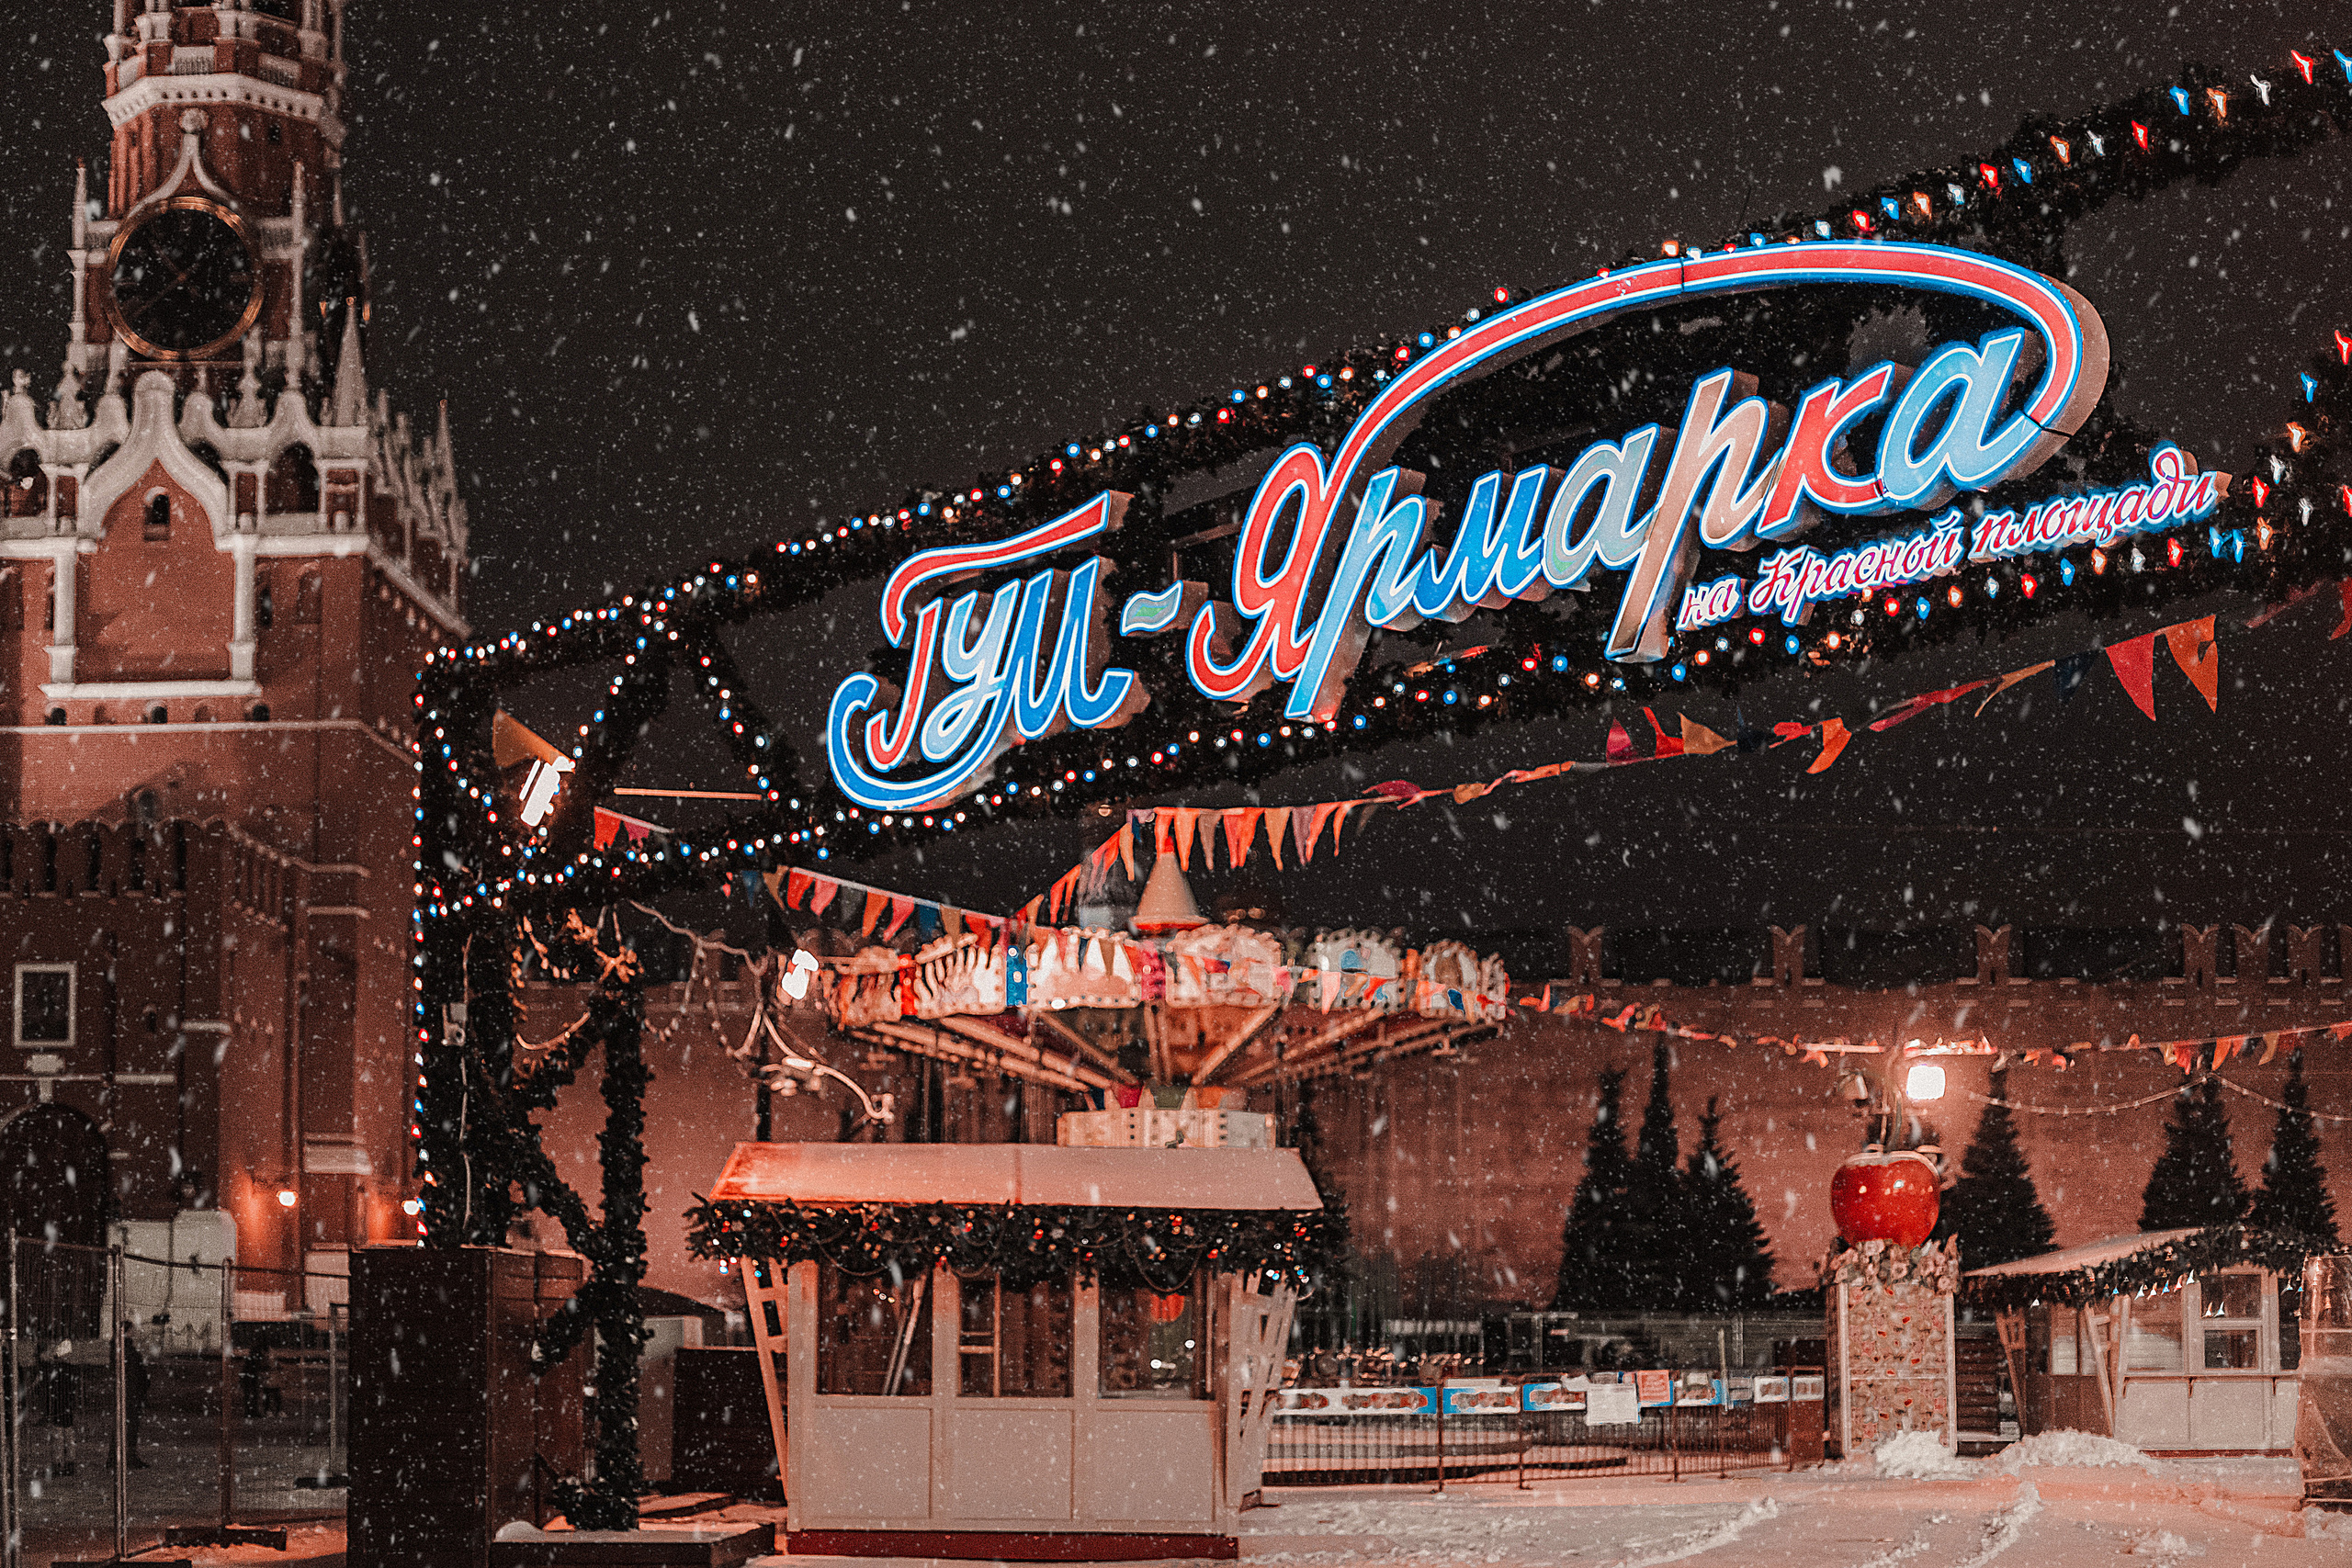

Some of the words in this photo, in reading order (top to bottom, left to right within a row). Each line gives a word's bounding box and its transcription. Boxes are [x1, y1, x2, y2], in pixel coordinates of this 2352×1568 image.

[1676, 576, 1740, 631] на
[1747, 507, 1965, 626] Красной
[1968, 446, 2219, 559] площади
